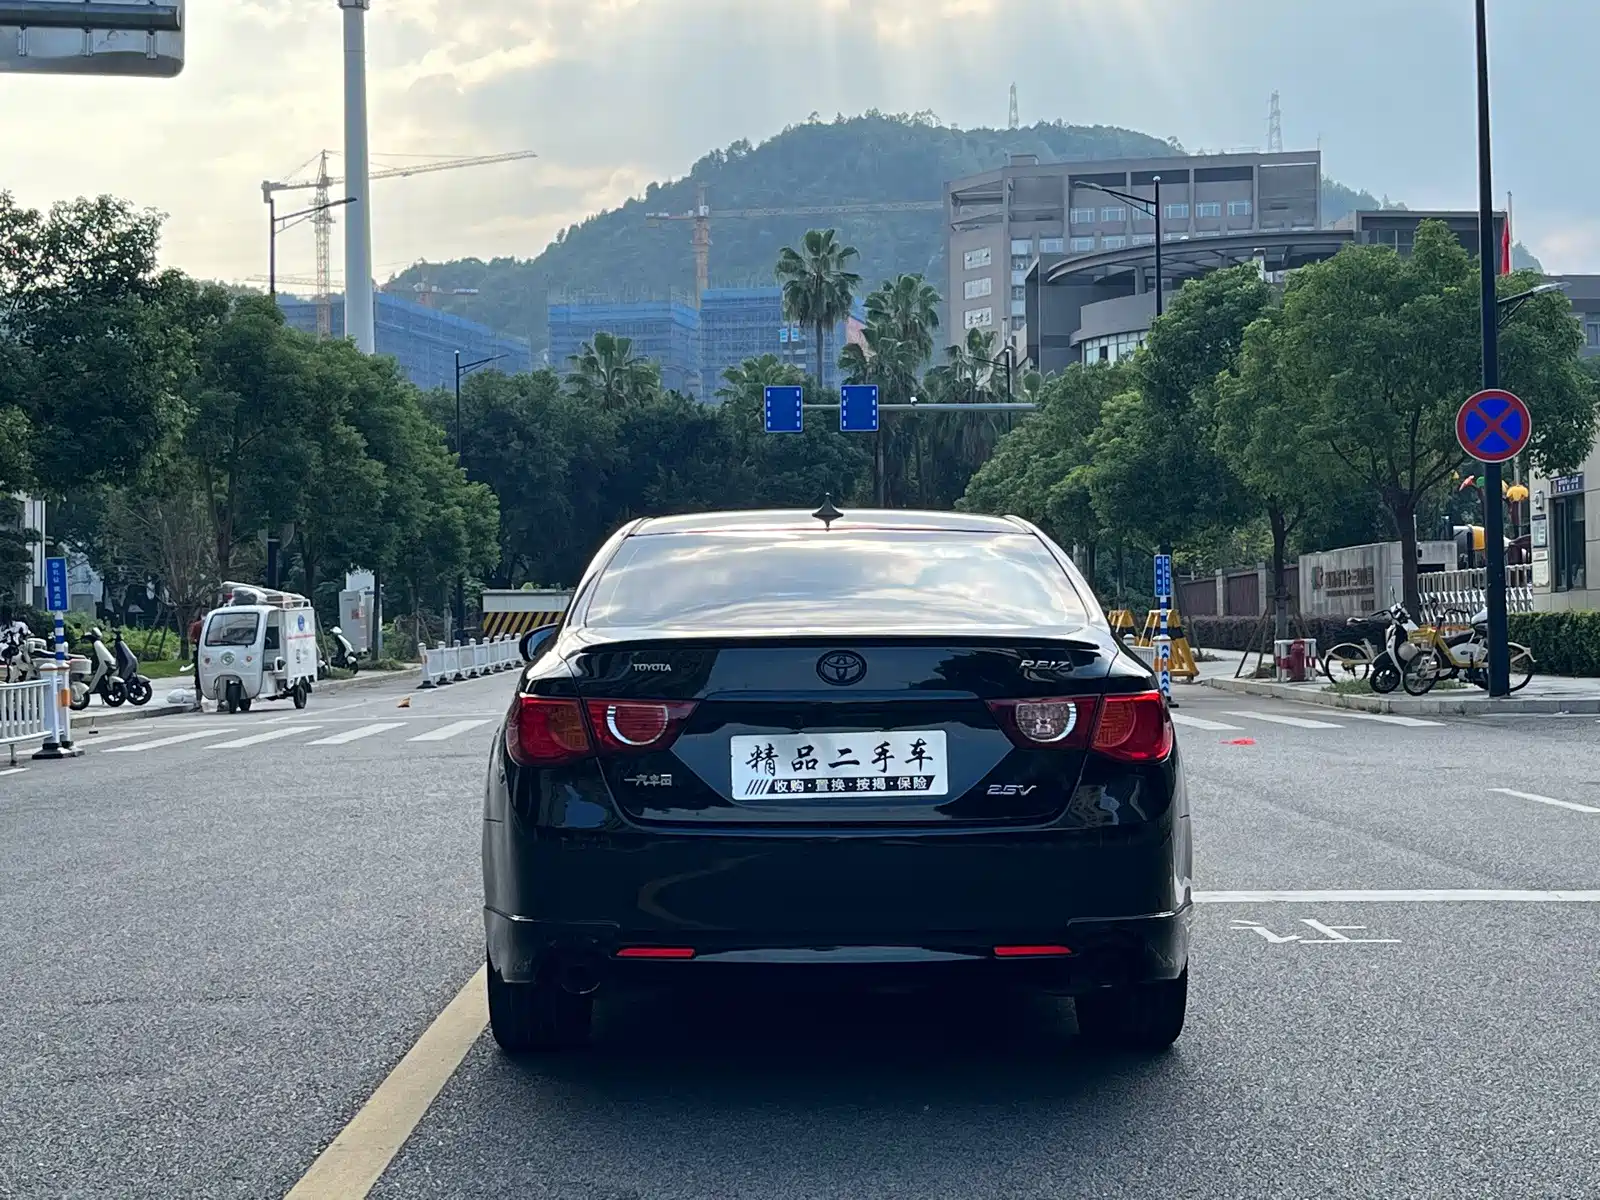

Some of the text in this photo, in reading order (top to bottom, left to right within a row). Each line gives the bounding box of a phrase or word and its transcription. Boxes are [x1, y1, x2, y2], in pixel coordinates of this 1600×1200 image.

[633, 663, 672, 672] TOYOTA
[1019, 659, 1070, 670] REIZ
[745, 738, 934, 777] 精品二手车
